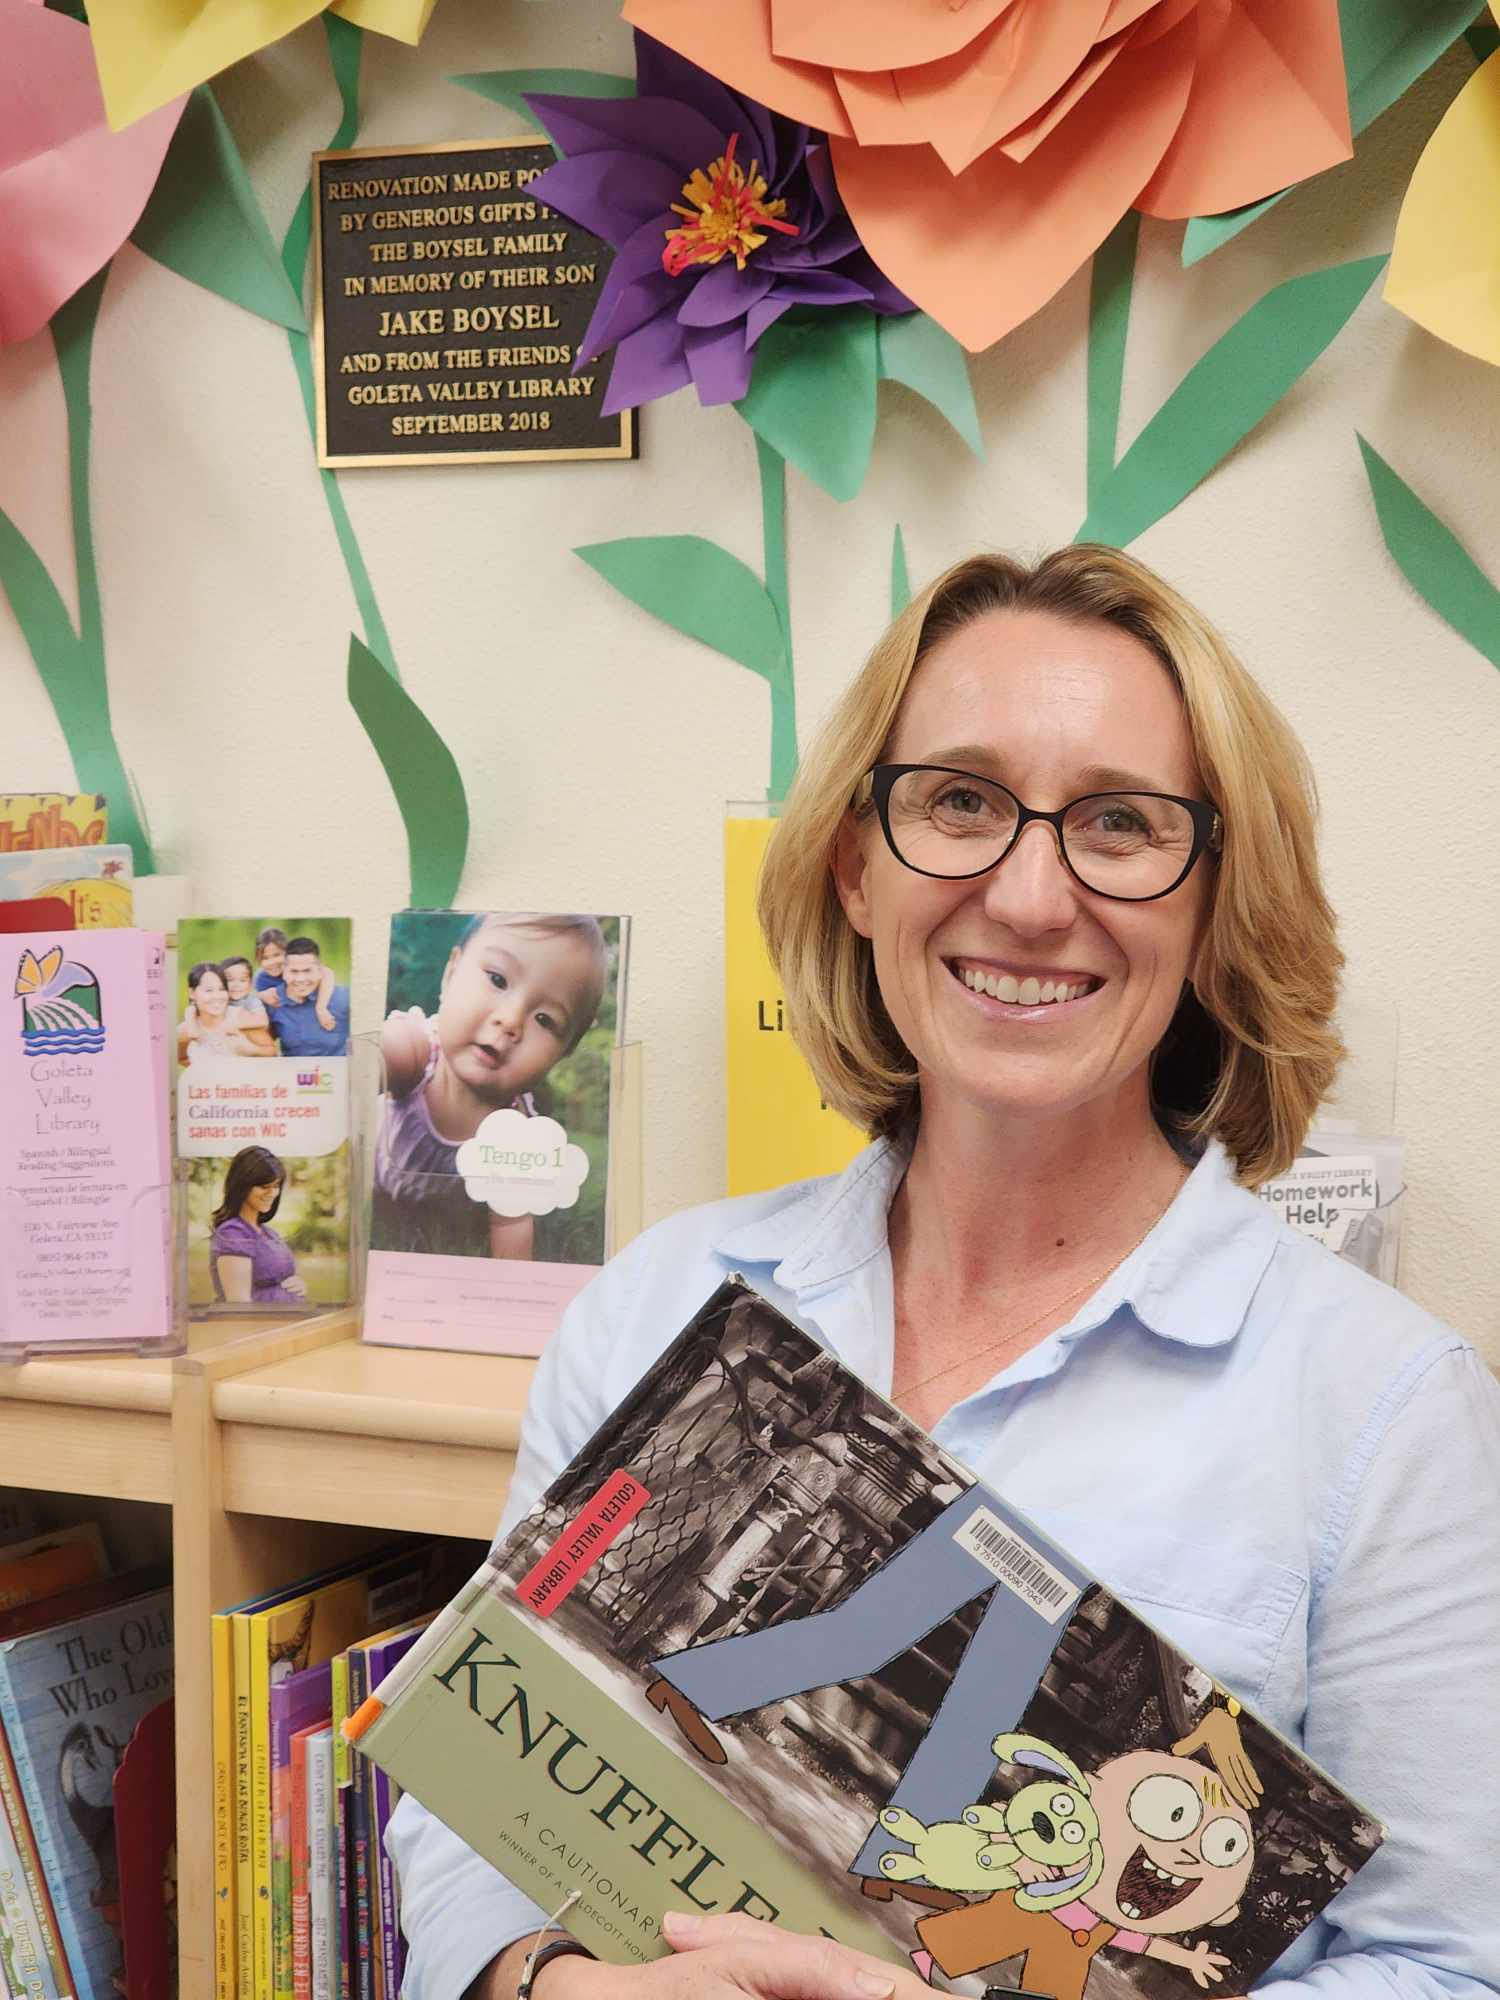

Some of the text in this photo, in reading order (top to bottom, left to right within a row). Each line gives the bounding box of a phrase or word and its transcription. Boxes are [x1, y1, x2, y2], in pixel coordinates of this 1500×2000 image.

[328, 174, 448, 200] RENOVATION
[453, 170, 512, 192] MADE
[340, 213, 367, 232] BY
[372, 205, 474, 229] GENEROUS
[479, 202, 537, 223] GIFTS
[369, 233, 567, 262] THE BOYSEL FAMILY
[344, 264, 597, 296] IN MEMORY OF THEIR SON
[379, 305, 560, 337] JAKE BOYSEL
[340, 354, 382, 374] AND
[385, 351, 440, 372] FROM
[444, 349, 483, 368] THE
[487, 345, 571, 367] FRIENDS
[348, 377, 595, 405] GOLETA VALLEY LIBRARY
[391, 411, 551, 436] SEPTEMBER 2018
[758, 1000, 784, 1032] Li
[30, 1059, 94, 1082] Goleta
[36, 1086, 92, 1110] Valley
[188, 1084, 289, 1100] Las familias de
[35, 1112, 101, 1136] Library
[188, 1105, 321, 1120] California crecen
[188, 1123, 288, 1139] sanas con WIC
[480, 1145, 565, 1171] Tengo 1
[1258, 1178, 1374, 1203] Homework
[1286, 1202, 1340, 1229] Help
[528, 1481, 636, 1609] GOLETA VALLEY LIBRARY
[972, 1542, 983, 1552] 3
[56, 1611, 172, 1676] The Old
[48, 1675, 118, 1718] Who
[121, 1660, 174, 1696] Lov
[432, 1626, 780, 1923] KNUFFLE
[514, 1811, 664, 1941] A CAUTIONARY
[498, 1830, 654, 1964] WINNER OF A CLDECOTT HON
[293, 1895, 309, 1958] DIBUJANDO
[294, 1962, 309, 1977] EN
